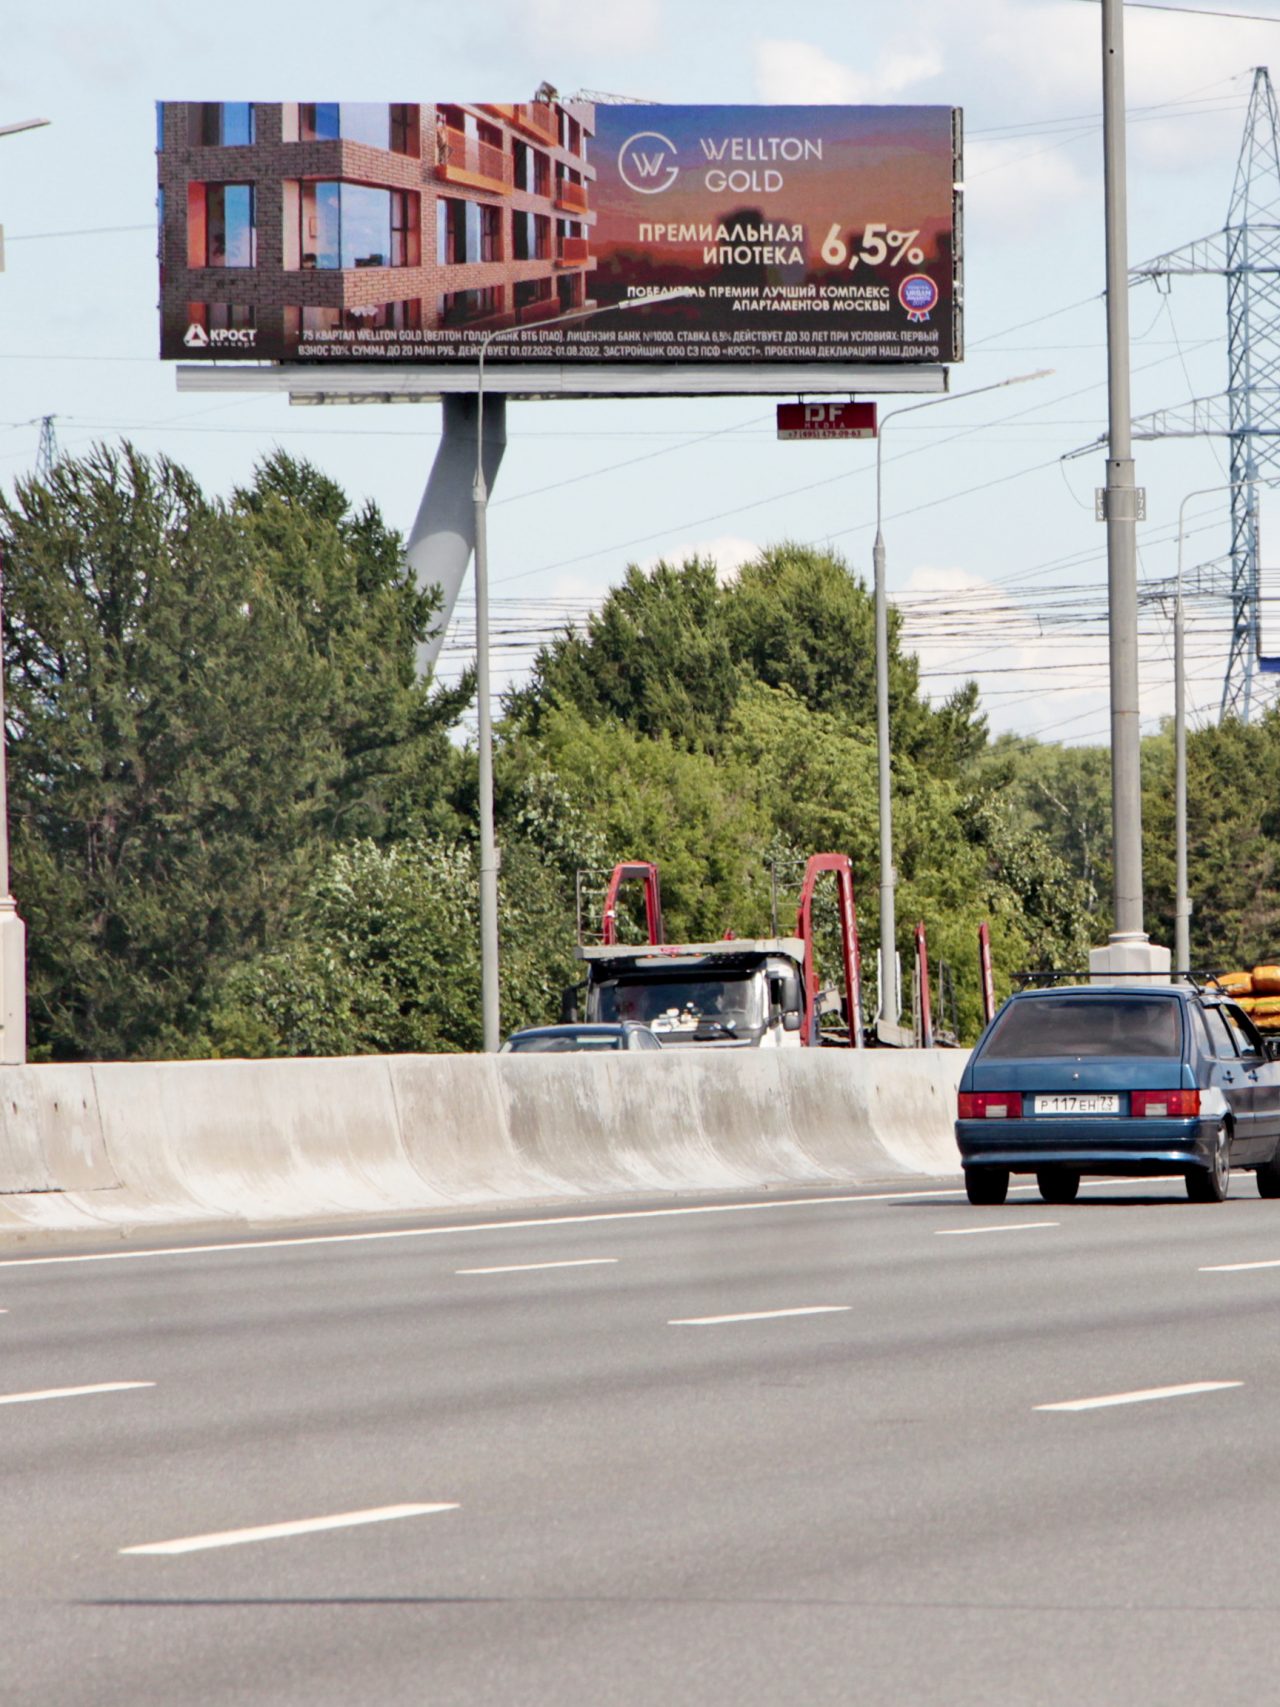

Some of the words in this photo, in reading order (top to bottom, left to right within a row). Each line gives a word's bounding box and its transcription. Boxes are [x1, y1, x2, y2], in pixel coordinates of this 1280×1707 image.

[700, 138, 823, 160] WELLTON
[705, 169, 783, 192] GOLD
[639, 224, 803, 242] ПРЕМИАЛЬНАЯ
[821, 223, 924, 271] 6,5%
[703, 246, 804, 264] ИПОТЕКА
[709, 286, 760, 297] ПРЕМИИ
[762, 284, 816, 297] ЛУЧШИЙ
[819, 286, 890, 298] КОМПЛЕКС
[732, 299, 830, 311] АПАРТАМЕНТОВ
[832, 299, 890, 311] МОСКВЫ
[210, 329, 257, 341] КРОСТ
[315, 330, 355, 341] КВАРТАЛ
[357, 329, 397, 341] WELLTON
[399, 330, 421, 341] GOLD
[521, 331, 537, 342] ВТБ
[566, 331, 615, 343] ЛИЦЕНЗИЯ
[617, 331, 641, 342] БАНК
[677, 331, 710, 342] СТАВКА
[711, 331, 731, 343] 6,5%
[733, 329, 782, 342] ДЕЙСТВУЕТ
[784, 331, 798, 342] ДО
[799, 331, 810, 341] 30
[811, 331, 828, 341] ЛЕТ
[830, 331, 849, 341] ПРИ
[850, 331, 899, 341] УСЛОВИЯХ:
[900, 329, 939, 341] ПЕРВЫЙ
[298, 345, 329, 356] ВЗНОС
[330, 345, 350, 356] 20%
[352, 345, 385, 356] СУММА
[386, 345, 400, 357] ДО
[402, 345, 413, 356] 20
[414, 345, 435, 356] МЛН
[603, 344, 665, 357] ЗАСТРОЙЩИК
[666, 346, 685, 356] ООО
[687, 346, 699, 356] СЗ
[700, 345, 721, 357] ПСФ
[764, 346, 816, 356] ПРОЕКТНАЯ
[817, 345, 877, 357] ДЕКЛАРАЦИЯ
[804, 404, 845, 421] DF
[1041, 1097, 1096, 1111] Р117ЕН
